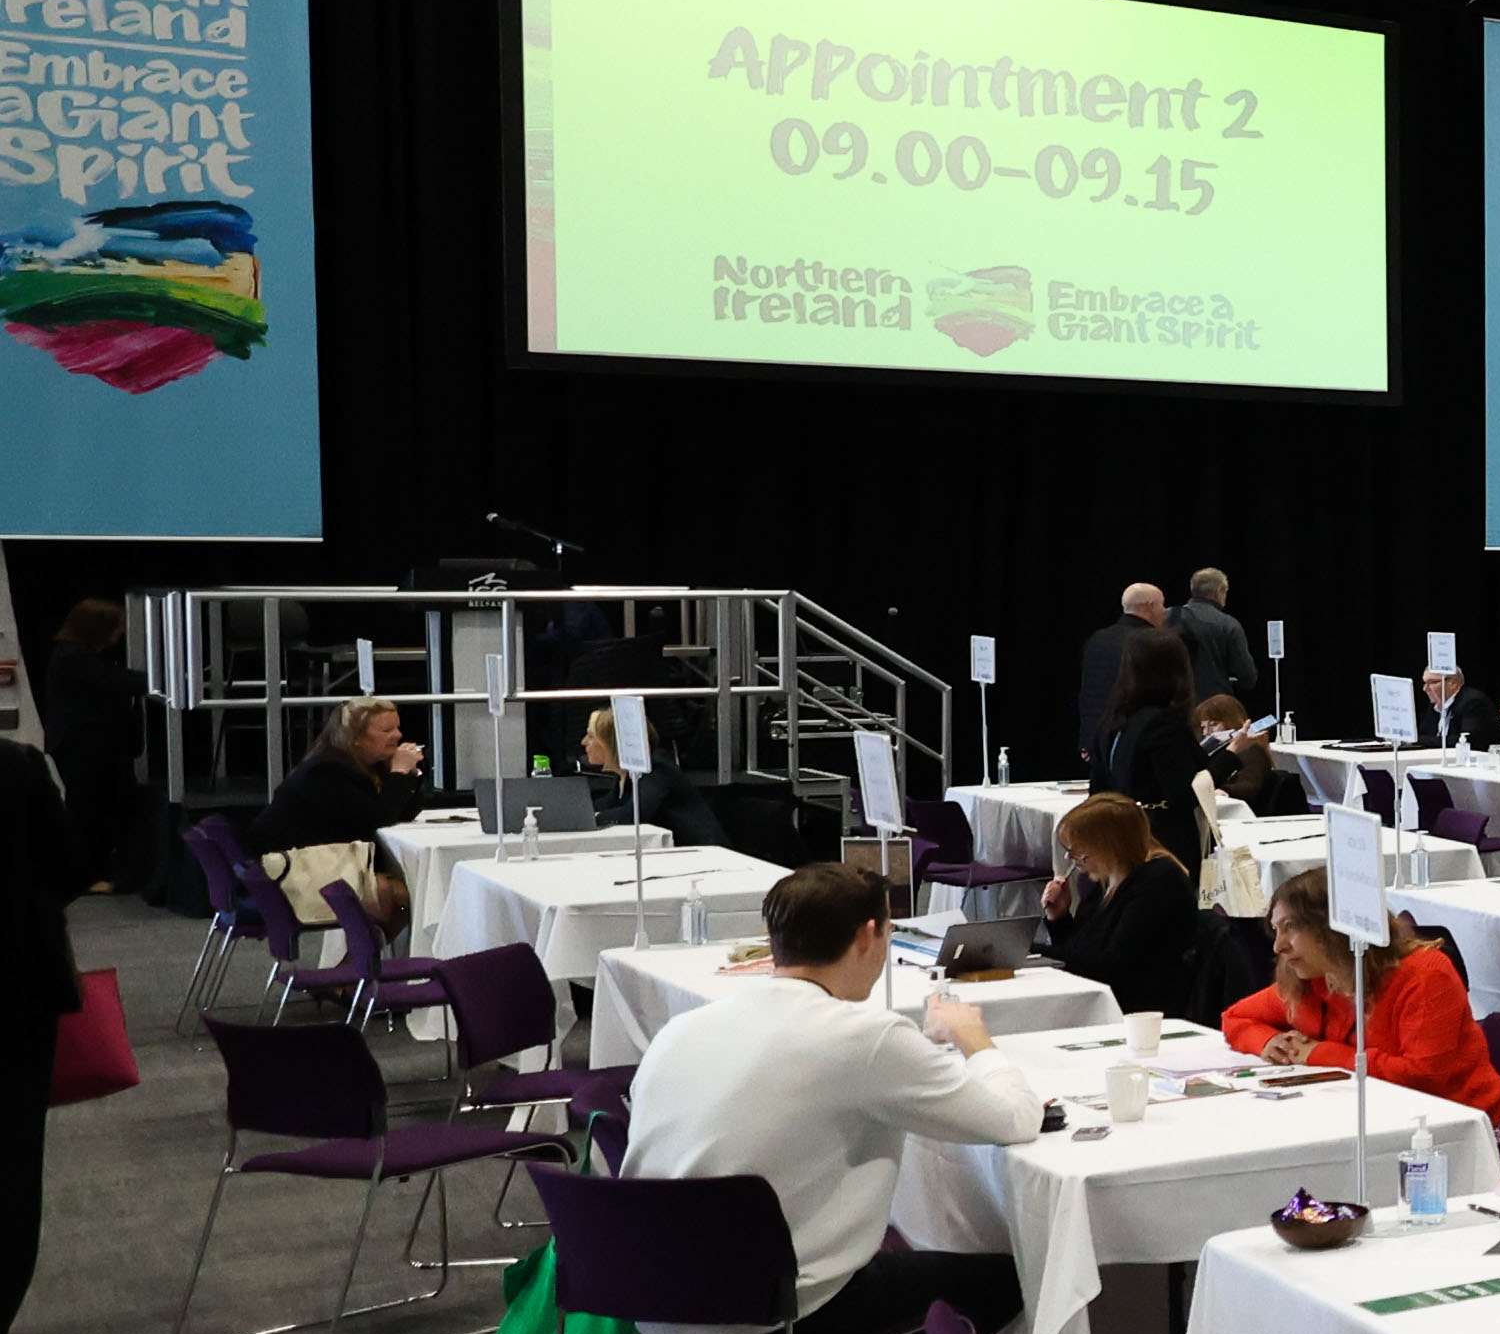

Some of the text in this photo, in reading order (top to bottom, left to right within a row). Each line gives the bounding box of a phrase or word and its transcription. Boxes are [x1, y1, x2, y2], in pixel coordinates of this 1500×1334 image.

[0, 40, 249, 100] Embrace
[1222, 88, 1264, 140] 2
[713, 255, 912, 296] Northern
[713, 286, 911, 330] Ireland
[1048, 280, 1233, 318] Embrace a
[1048, 311, 1263, 351] Giant Spirit
